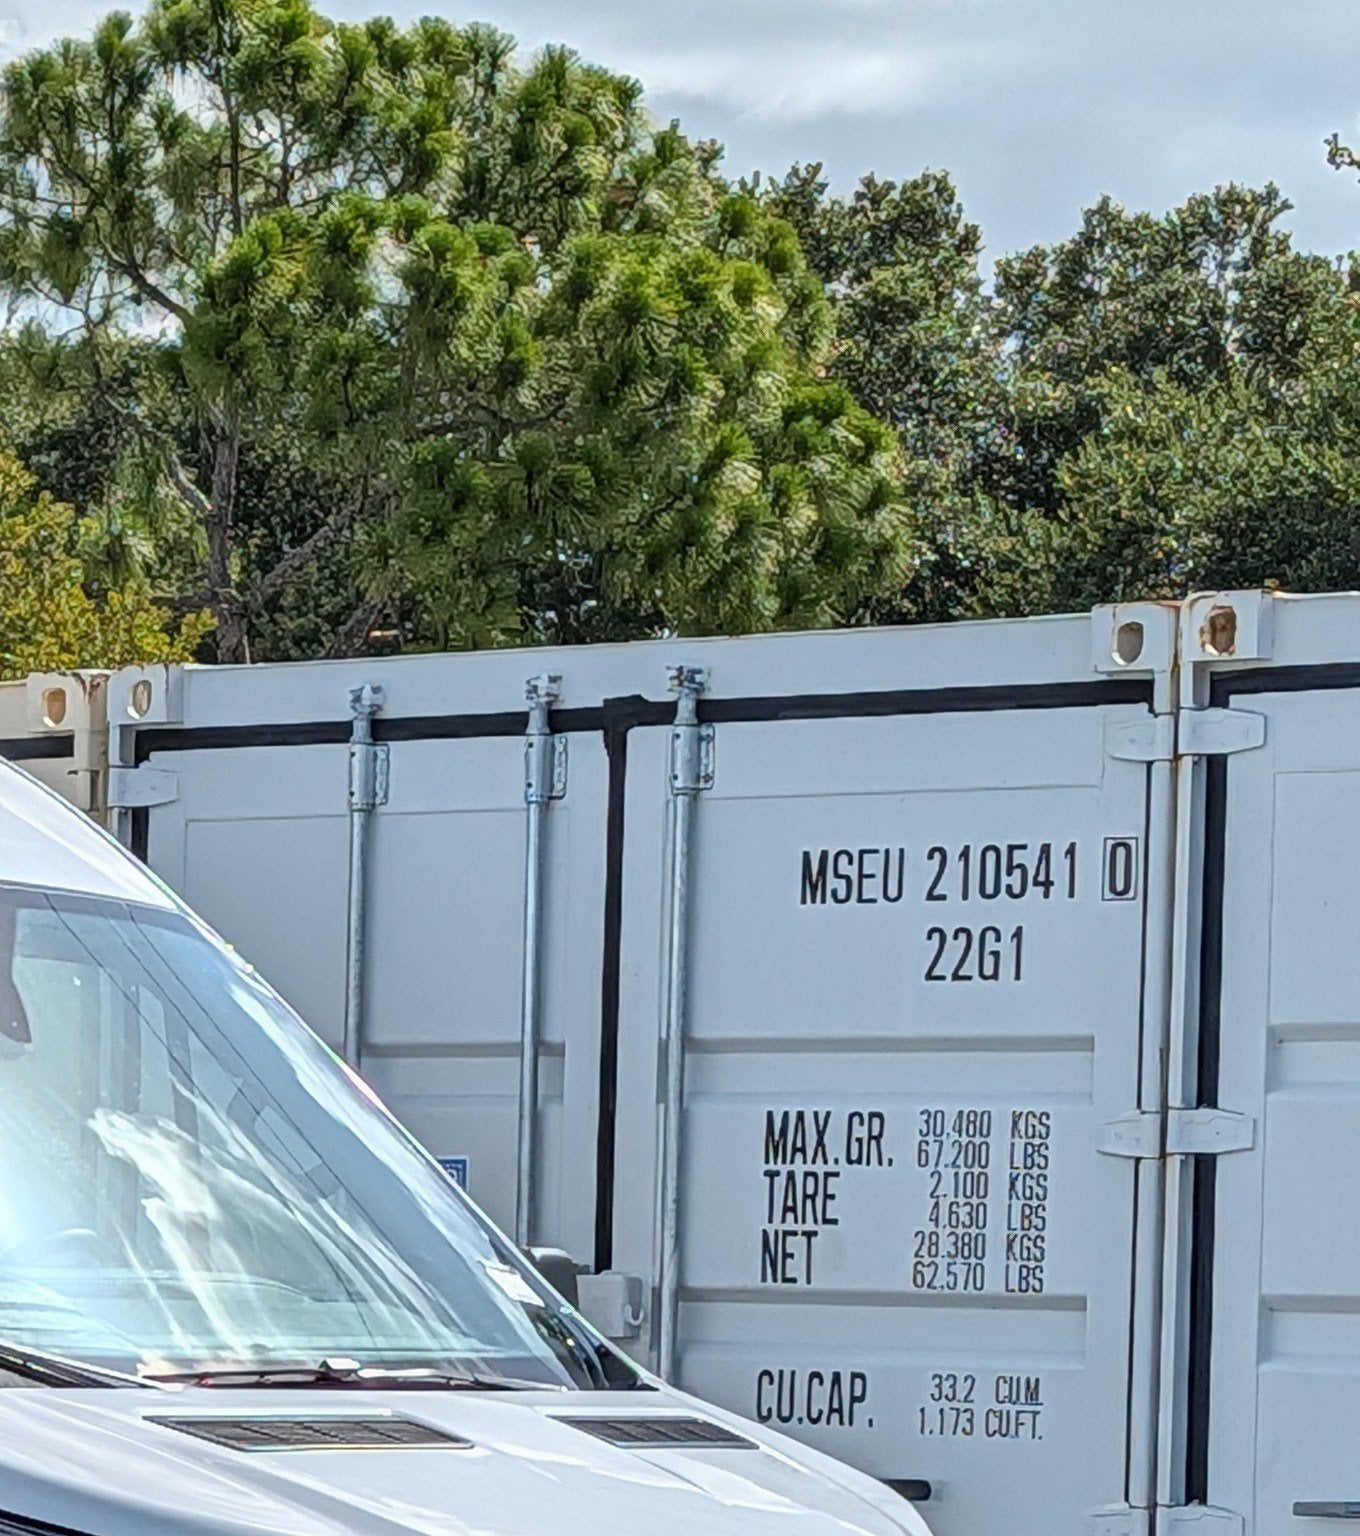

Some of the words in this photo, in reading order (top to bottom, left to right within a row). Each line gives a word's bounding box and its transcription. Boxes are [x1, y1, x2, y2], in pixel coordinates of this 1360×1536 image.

[799, 847, 905, 905] MSEU
[925, 841, 1077, 901] 210541
[924, 925, 1024, 982] 22G1
[763, 1110, 894, 1167] MAX.GR.
[918, 1109, 993, 1138] 30.480
[1010, 1110, 1051, 1141] KGS
[916, 1140, 990, 1170] 67.200
[1009, 1141, 1050, 1171] LBS
[762, 1169, 841, 1226] TARE
[929, 1170, 989, 1200] 2.100
[1007, 1171, 1049, 1202] KGS
[928, 1201, 988, 1231] 4.630
[1006, 1202, 1047, 1232] LBS
[760, 1228, 819, 1286] NET
[913, 1230, 987, 1261] 28.380
[1005, 1233, 1046, 1263] KGS
[911, 1261, 986, 1292] 62.570
[1004, 1264, 1044, 1294] LBS
[755, 1369, 874, 1429] CU.CAP.
[930, 1373, 977, 1404] 33.2
[919, 1406, 975, 1436] 1.173
